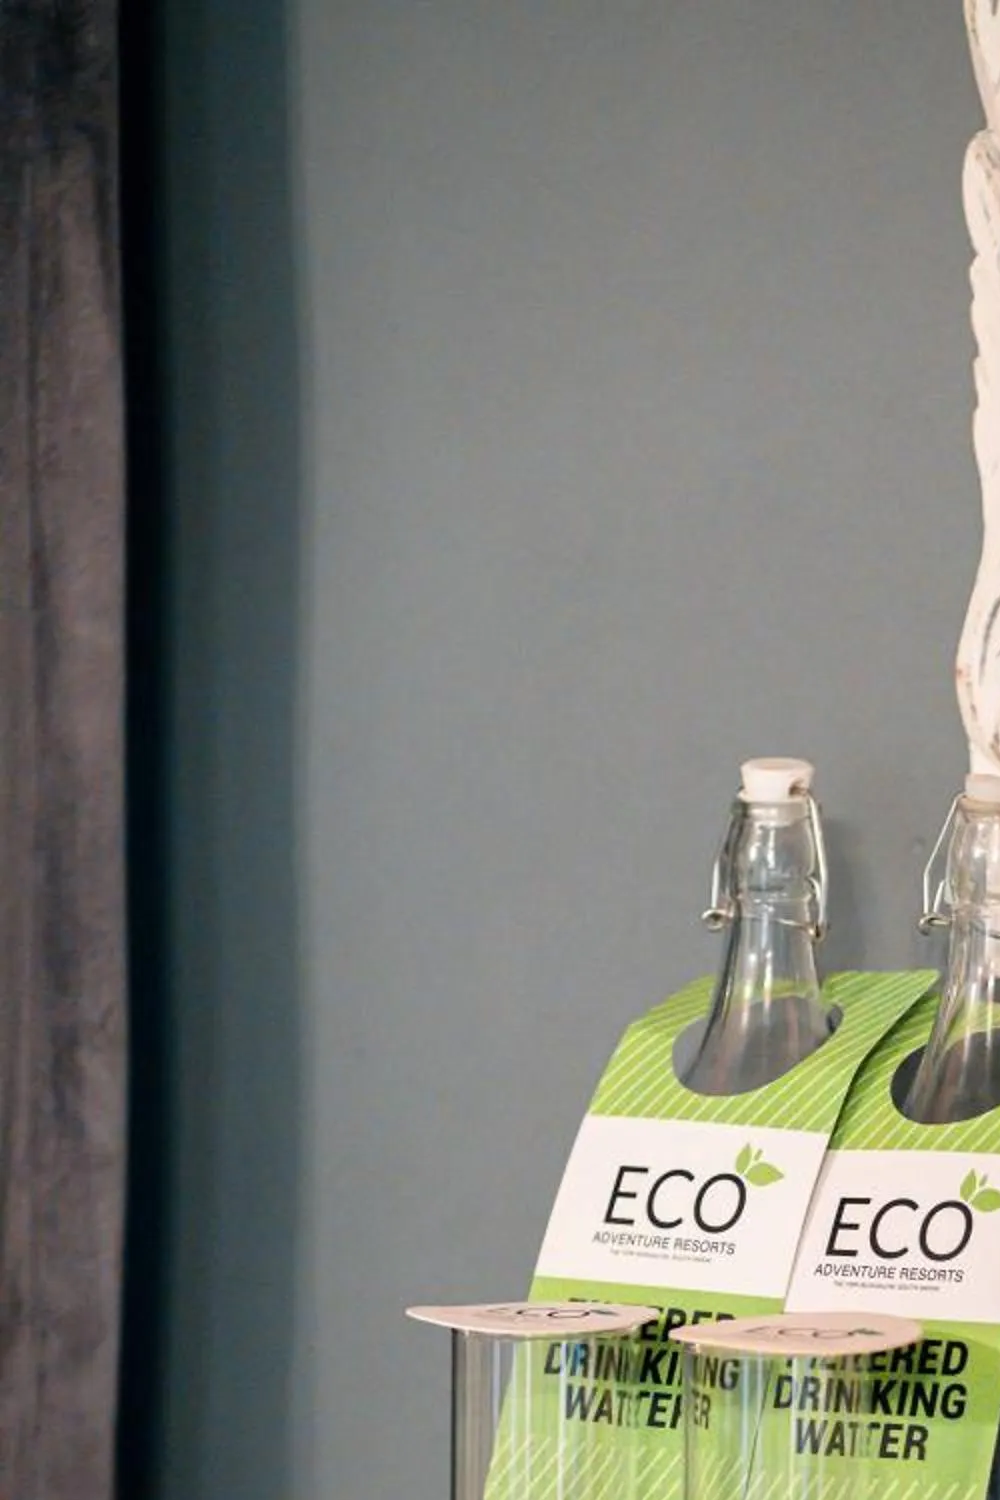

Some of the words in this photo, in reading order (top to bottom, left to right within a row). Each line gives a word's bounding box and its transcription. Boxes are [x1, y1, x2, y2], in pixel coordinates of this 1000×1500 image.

[603, 1165, 748, 1234] ECO
[592, 1231, 671, 1250] ADVENTURE
[673, 1237, 737, 1255] RESORTS
[825, 1197, 974, 1262] ECO
[813, 1263, 897, 1279] ADVENTURE
[899, 1267, 965, 1283] RESORTS
[773, 1374, 969, 1420] DRINKING
